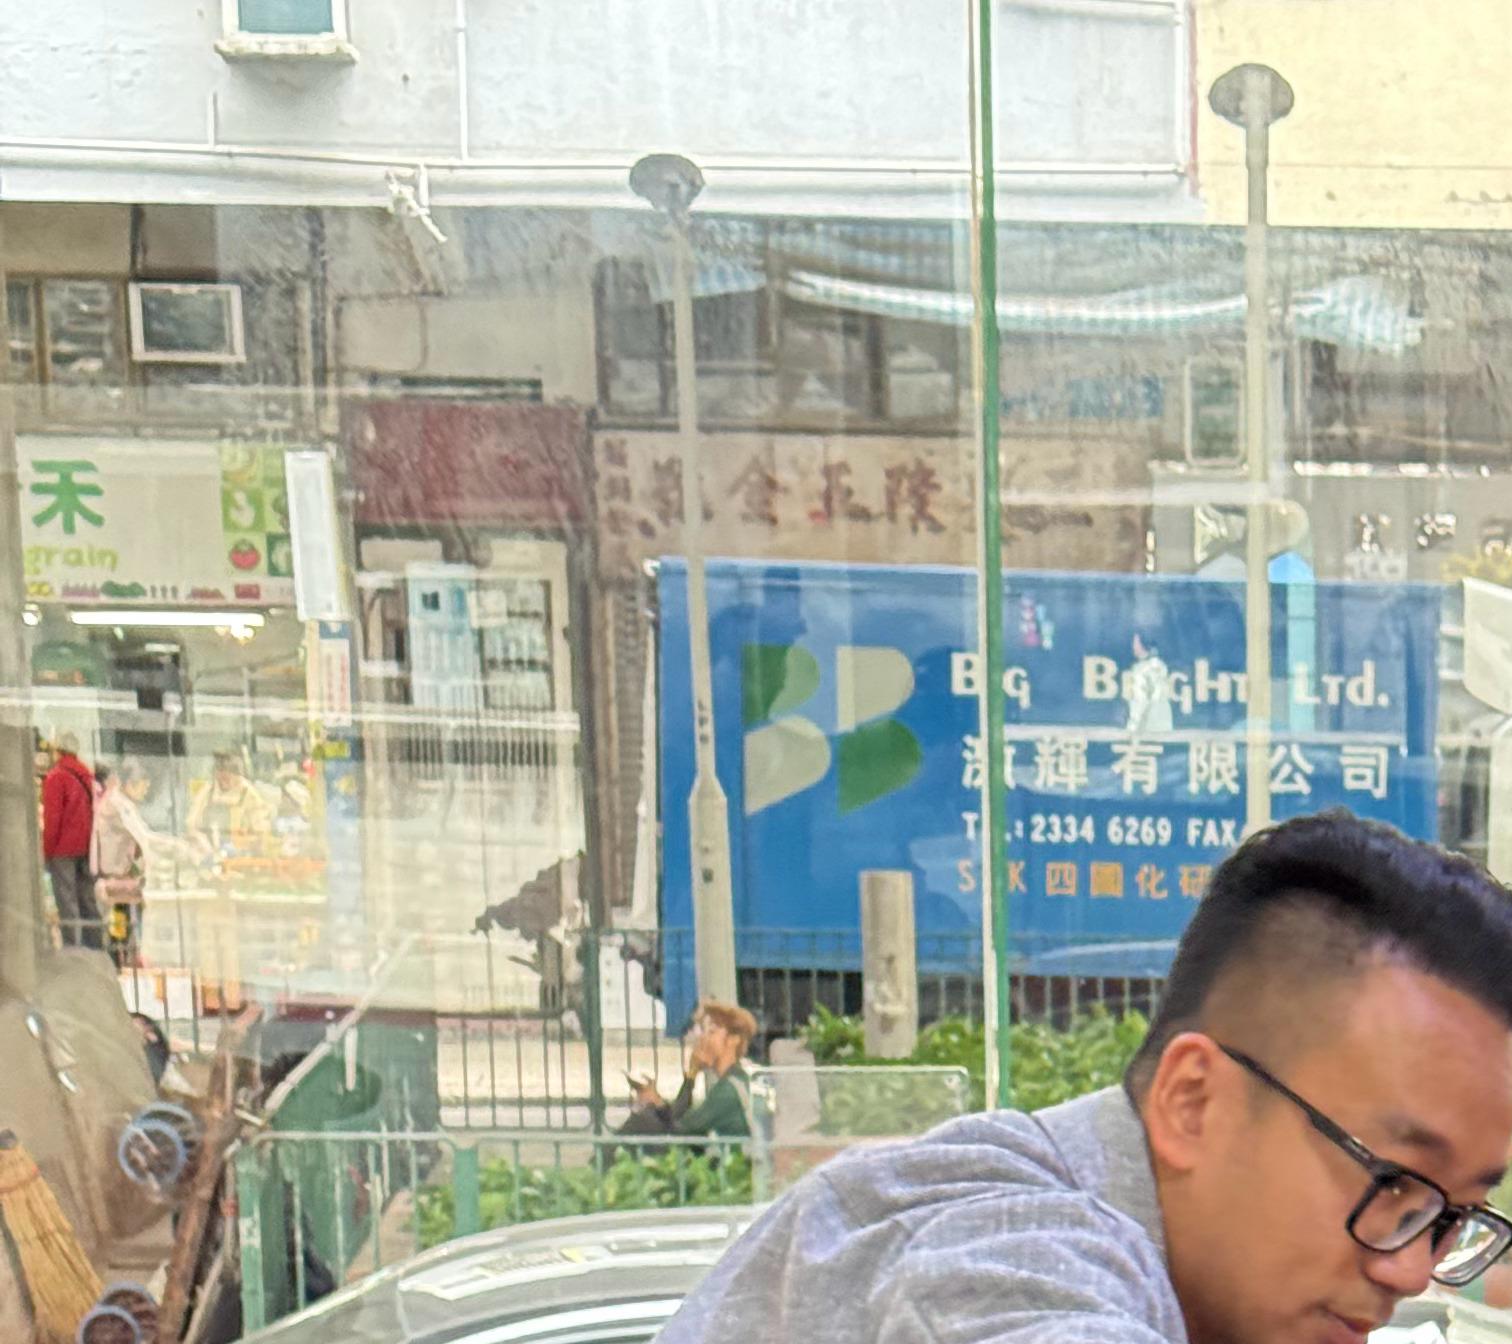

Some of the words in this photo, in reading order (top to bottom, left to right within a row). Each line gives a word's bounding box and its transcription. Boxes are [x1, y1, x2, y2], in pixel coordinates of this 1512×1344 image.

[950, 652, 1031, 710] Bg
[1030, 813, 1096, 845] 2334
[1106, 815, 1173, 847] 6269
[957, 858, 1027, 894] SK
